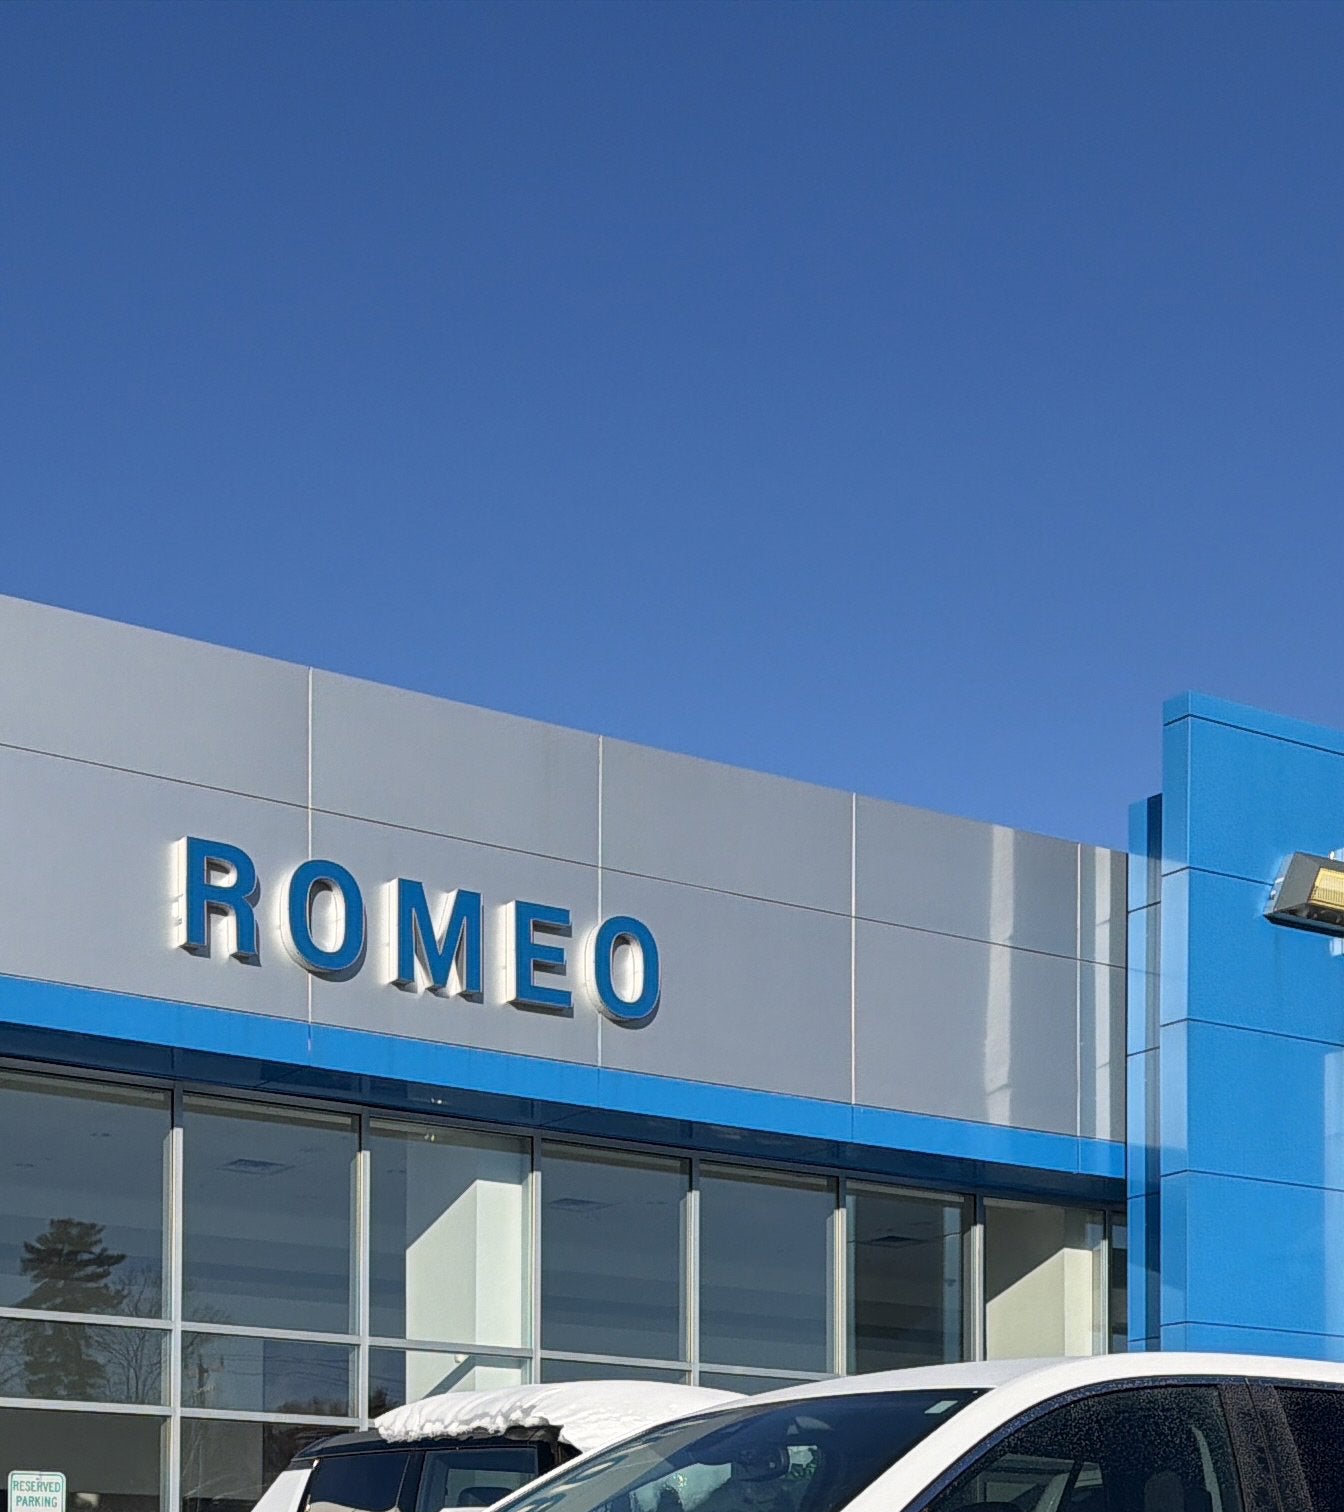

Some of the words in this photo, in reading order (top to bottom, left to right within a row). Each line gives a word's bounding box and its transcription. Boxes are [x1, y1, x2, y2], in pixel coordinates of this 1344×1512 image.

[179, 836, 661, 1022] ROMEO
[12, 1480, 61, 1493] RESERVED
[15, 1495, 58, 1508] PARKING
